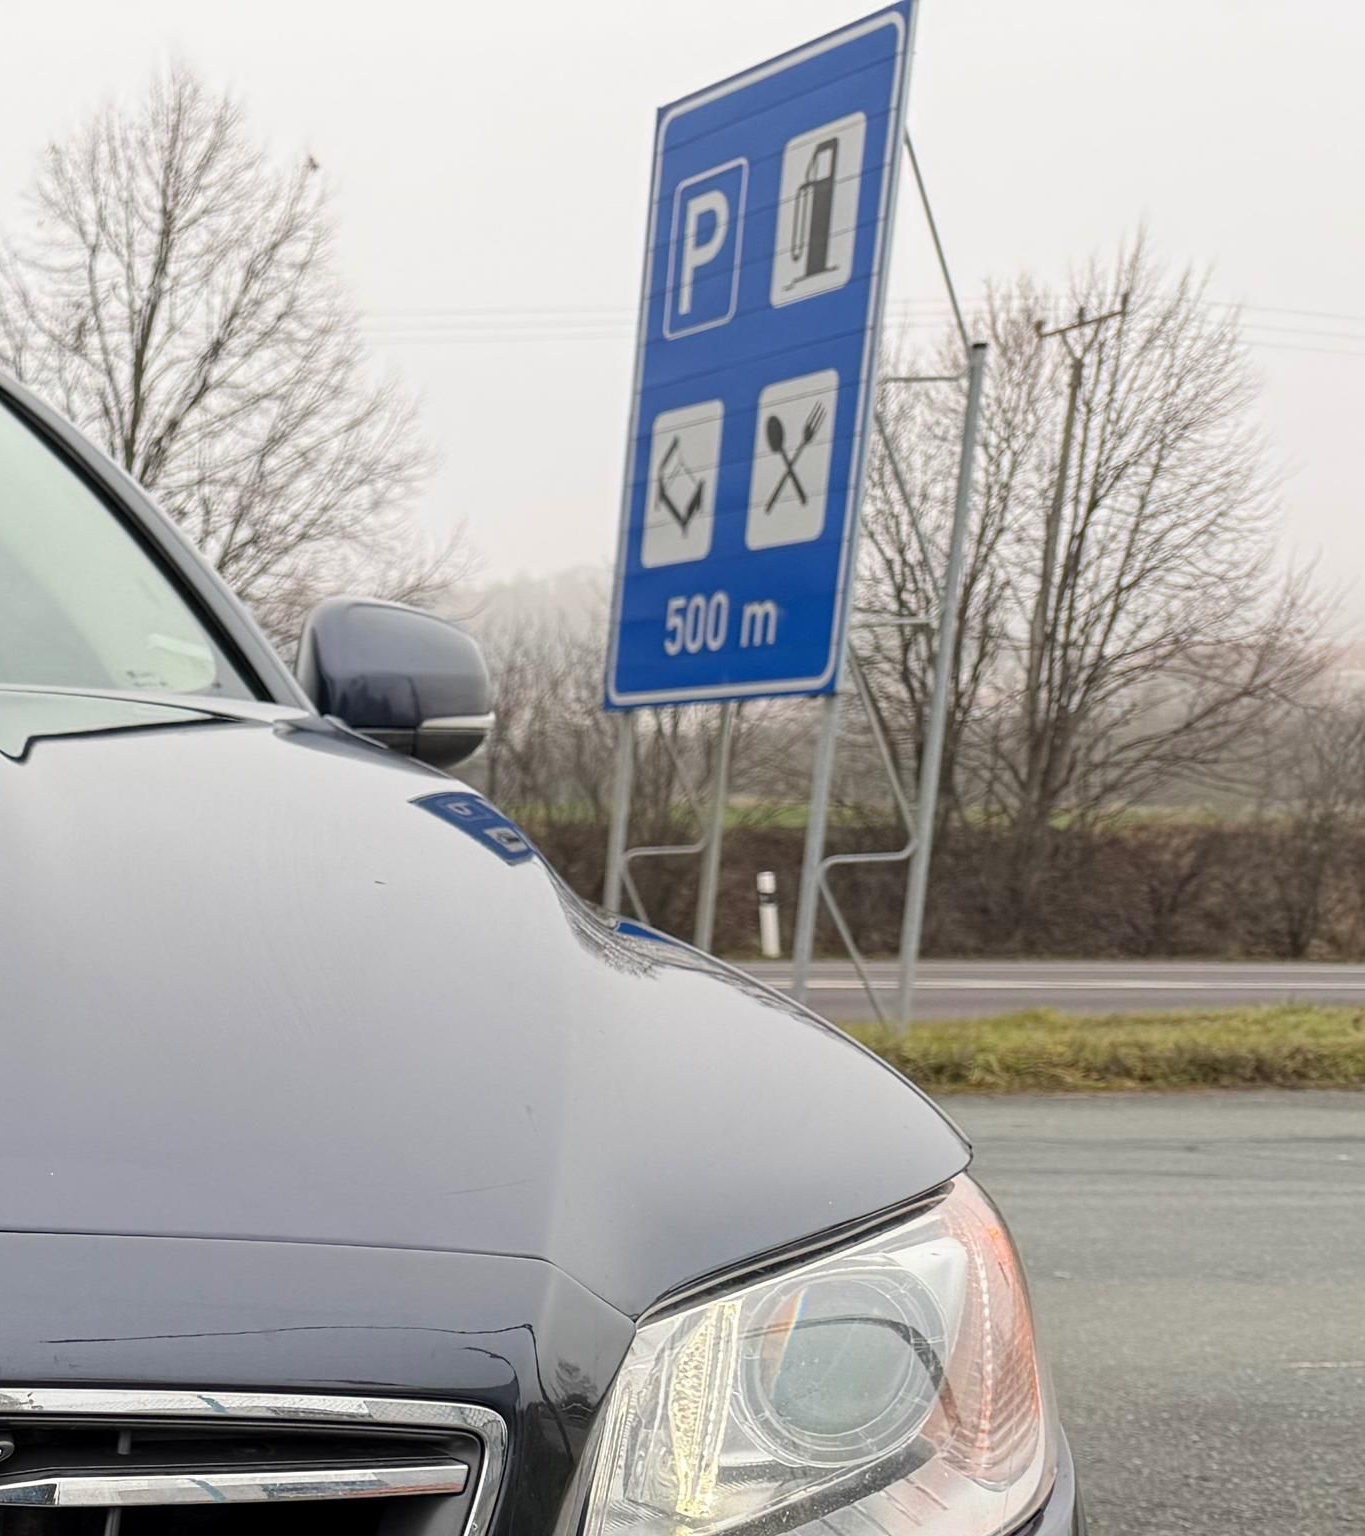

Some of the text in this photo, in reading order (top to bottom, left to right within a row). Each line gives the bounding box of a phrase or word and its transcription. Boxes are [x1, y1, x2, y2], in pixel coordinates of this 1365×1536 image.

[678, 189, 729, 315] P
[664, 591, 777, 656] 500 m
